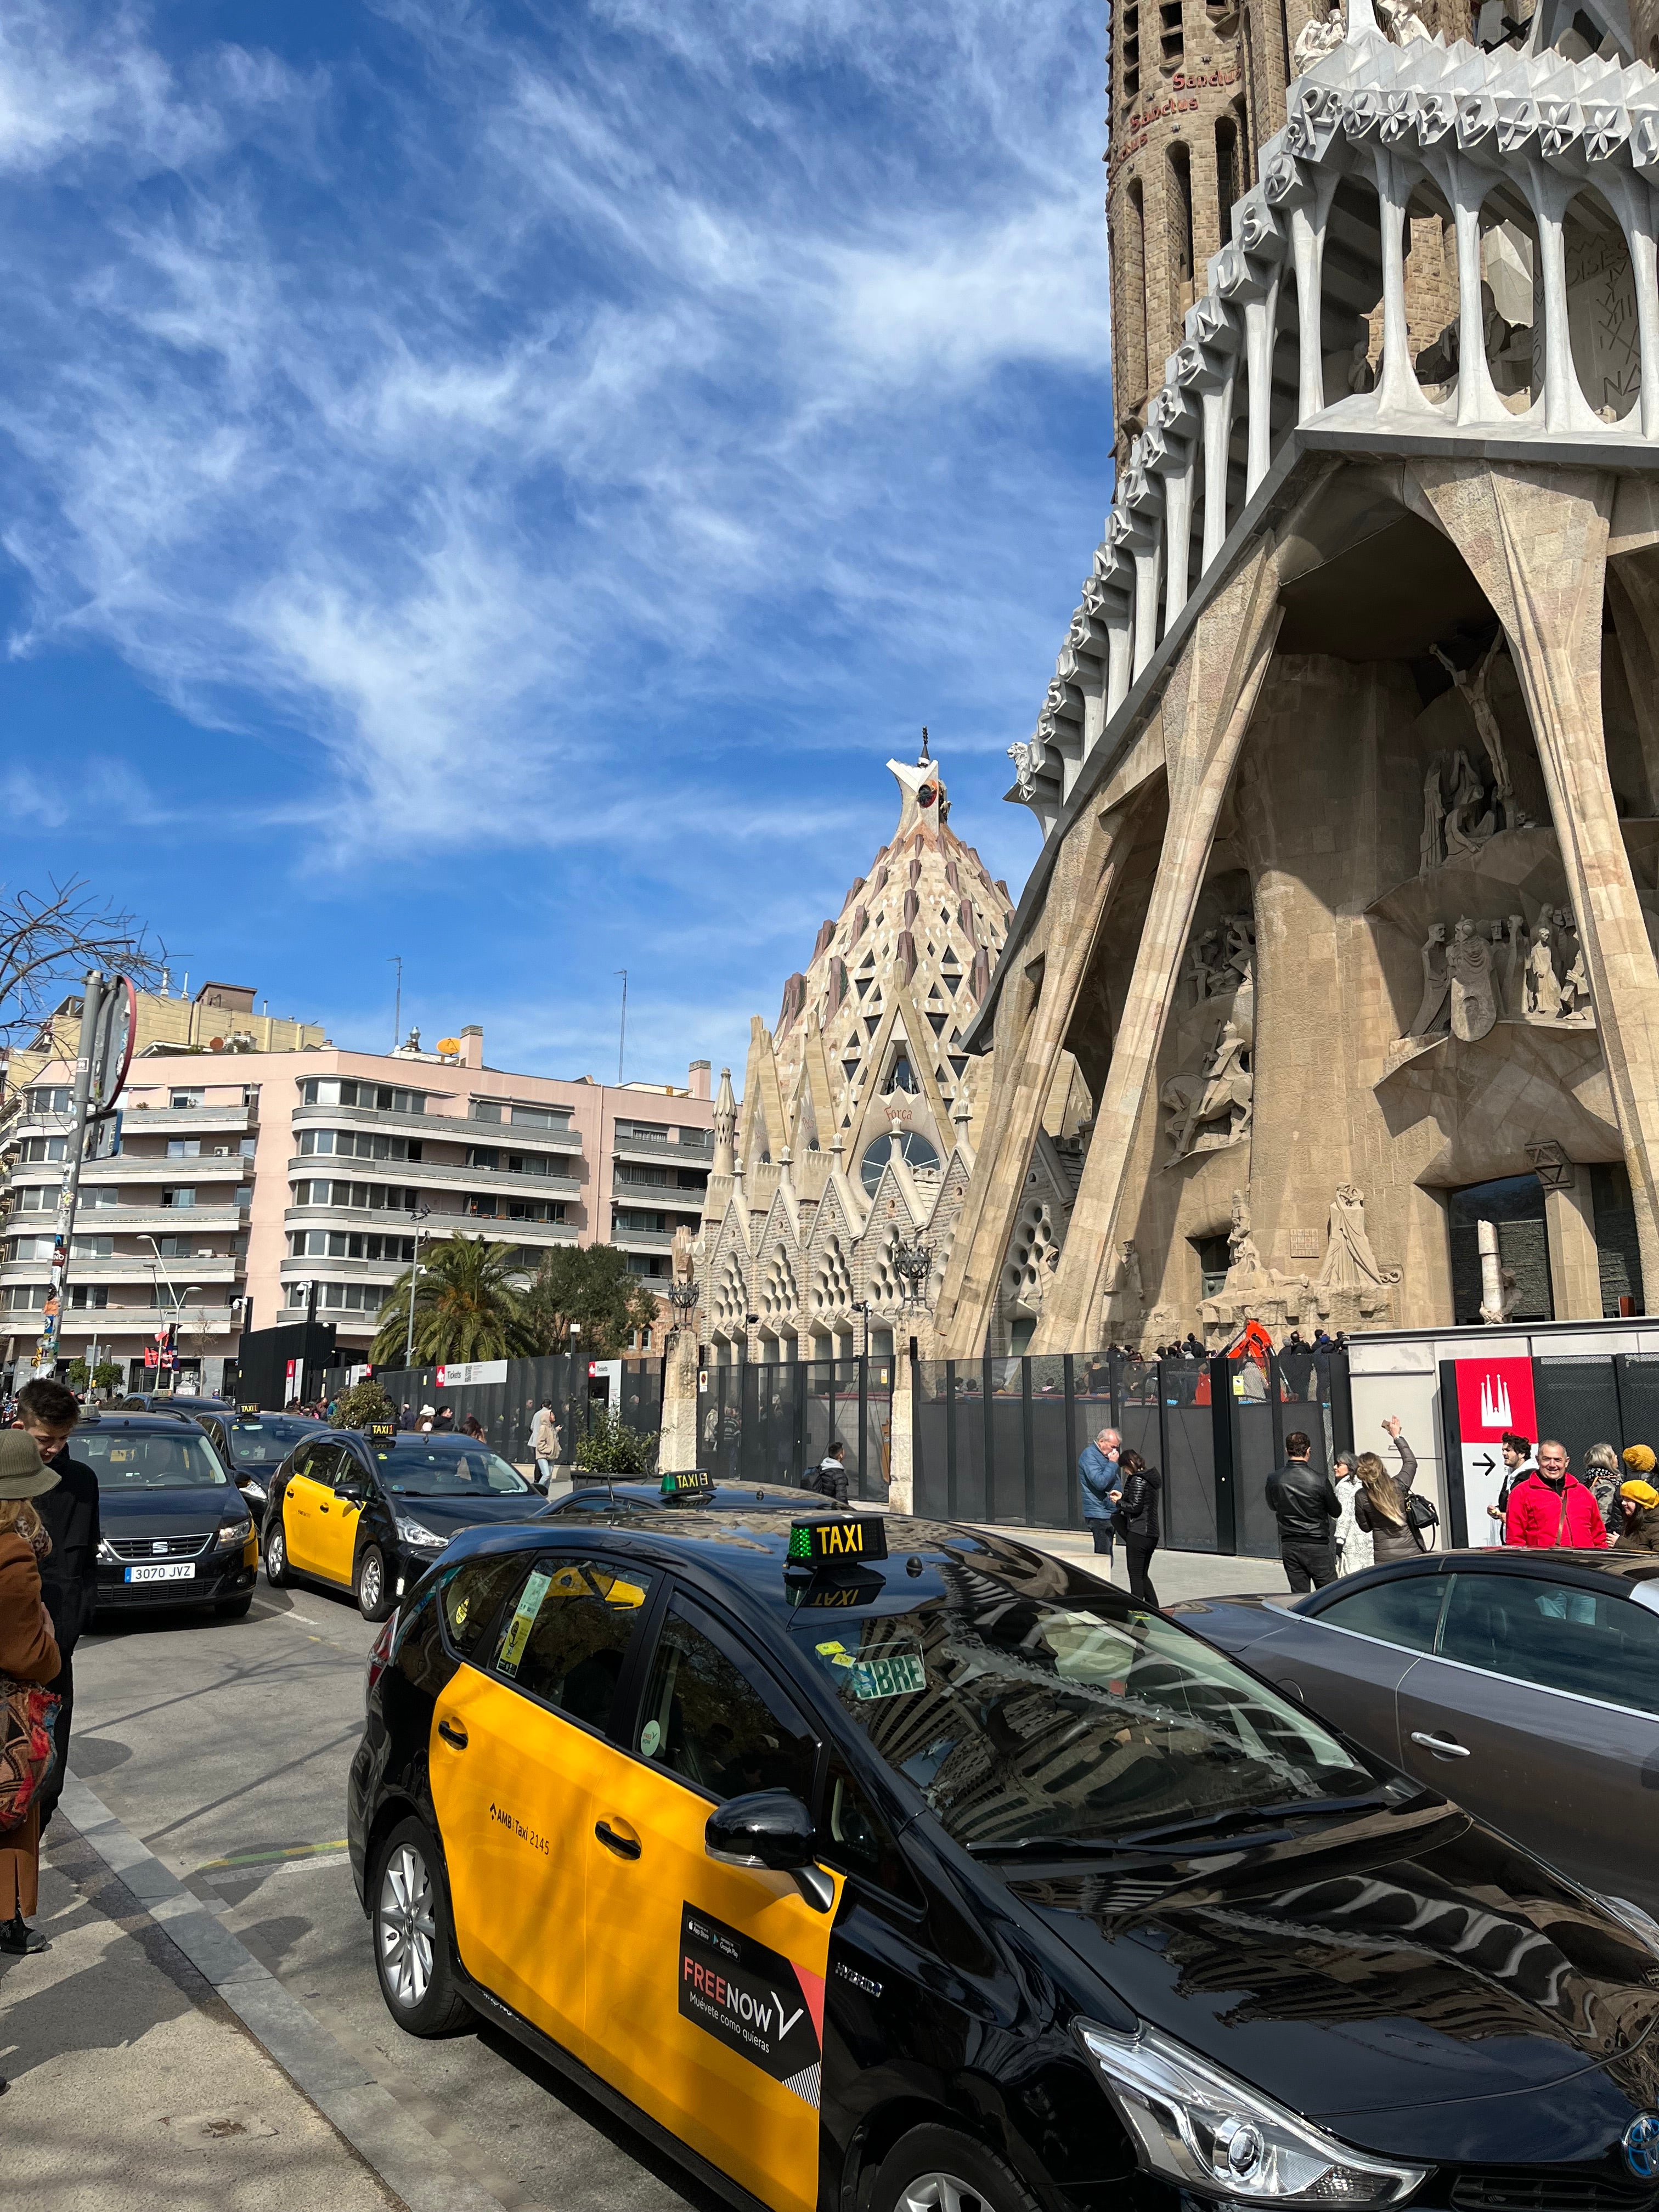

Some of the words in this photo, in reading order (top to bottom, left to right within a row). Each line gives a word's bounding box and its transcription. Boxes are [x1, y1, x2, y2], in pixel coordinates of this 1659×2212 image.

[1130, 98, 1198, 133] Sanctus
[884, 1105, 912, 1121] Força
[447, 1370, 461, 1379] Tickets
[373, 1425, 388, 1434] TAXI
[389, 1425, 393, 1434] 1
[676, 1474, 698, 1488] TAXI
[816, 1524, 863, 1554] TAXI
[136, 1568, 165, 1579] 3070
[169, 1566, 190, 1577] JVZ
[497, 1809, 512, 1829] AMB
[515, 1820, 528, 1841] Taxi
[530, 1831, 549, 1855] 2145
[700, 1930, 709, 1940] Store
[720, 1942, 731, 1954] Google
[690, 1991, 719, 2019] Muévete
[720, 2014, 741, 2034] como
[742, 2028, 769, 2053] quieras
